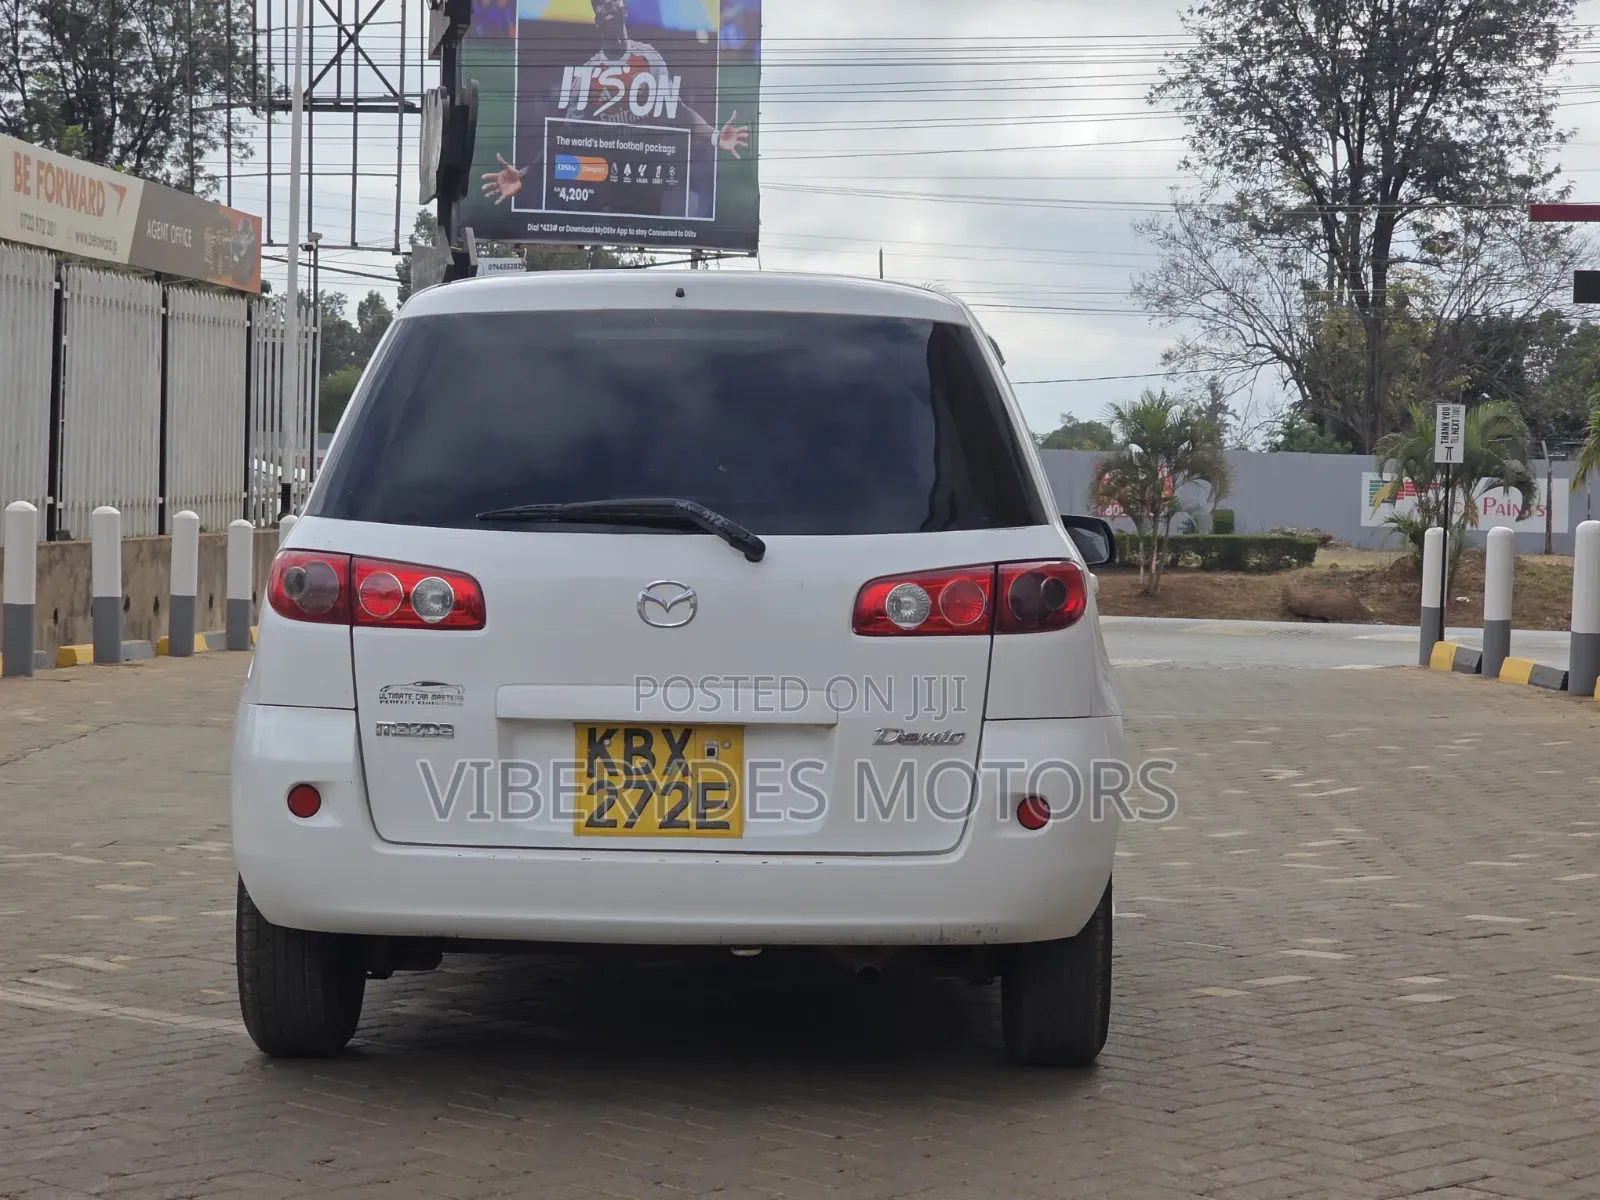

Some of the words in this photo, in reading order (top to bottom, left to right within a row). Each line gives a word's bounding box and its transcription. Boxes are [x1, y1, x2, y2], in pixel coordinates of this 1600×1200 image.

[558, 66, 630, 117] IT'S
[629, 71, 682, 119] ON
[556, 135, 570, 146] The
[571, 137, 598, 148] world's
[599, 138, 616, 149] best
[616, 139, 644, 152] football
[644, 143, 676, 156] package
[557, 163, 578, 171] DStv
[14, 151, 31, 197] BE
[36, 159, 106, 219] FORWARD
[559, 187, 589, 202] 4,200
[146, 219, 169, 242] AGENT
[170, 224, 192, 248] OFFICE
[527, 223, 539, 231] Dial
[565, 224, 594, 234] Download
[616, 227, 628, 236] App
[628, 227, 635, 235] to
[635, 228, 647, 238] stay
[647, 228, 678, 237] Connected
[678, 229, 684, 237] to
[1441, 406, 1451, 420] YOU
[1440, 421, 1450, 444] THANK
[1451, 419, 1460, 435] NEXT
[379, 692, 413, 701] ULTIMATE
[415, 693, 429, 701] CAR
[431, 694, 464, 702] MASTERS
[586, 727, 694, 779] KBX
[585, 779, 731, 830] 272E
